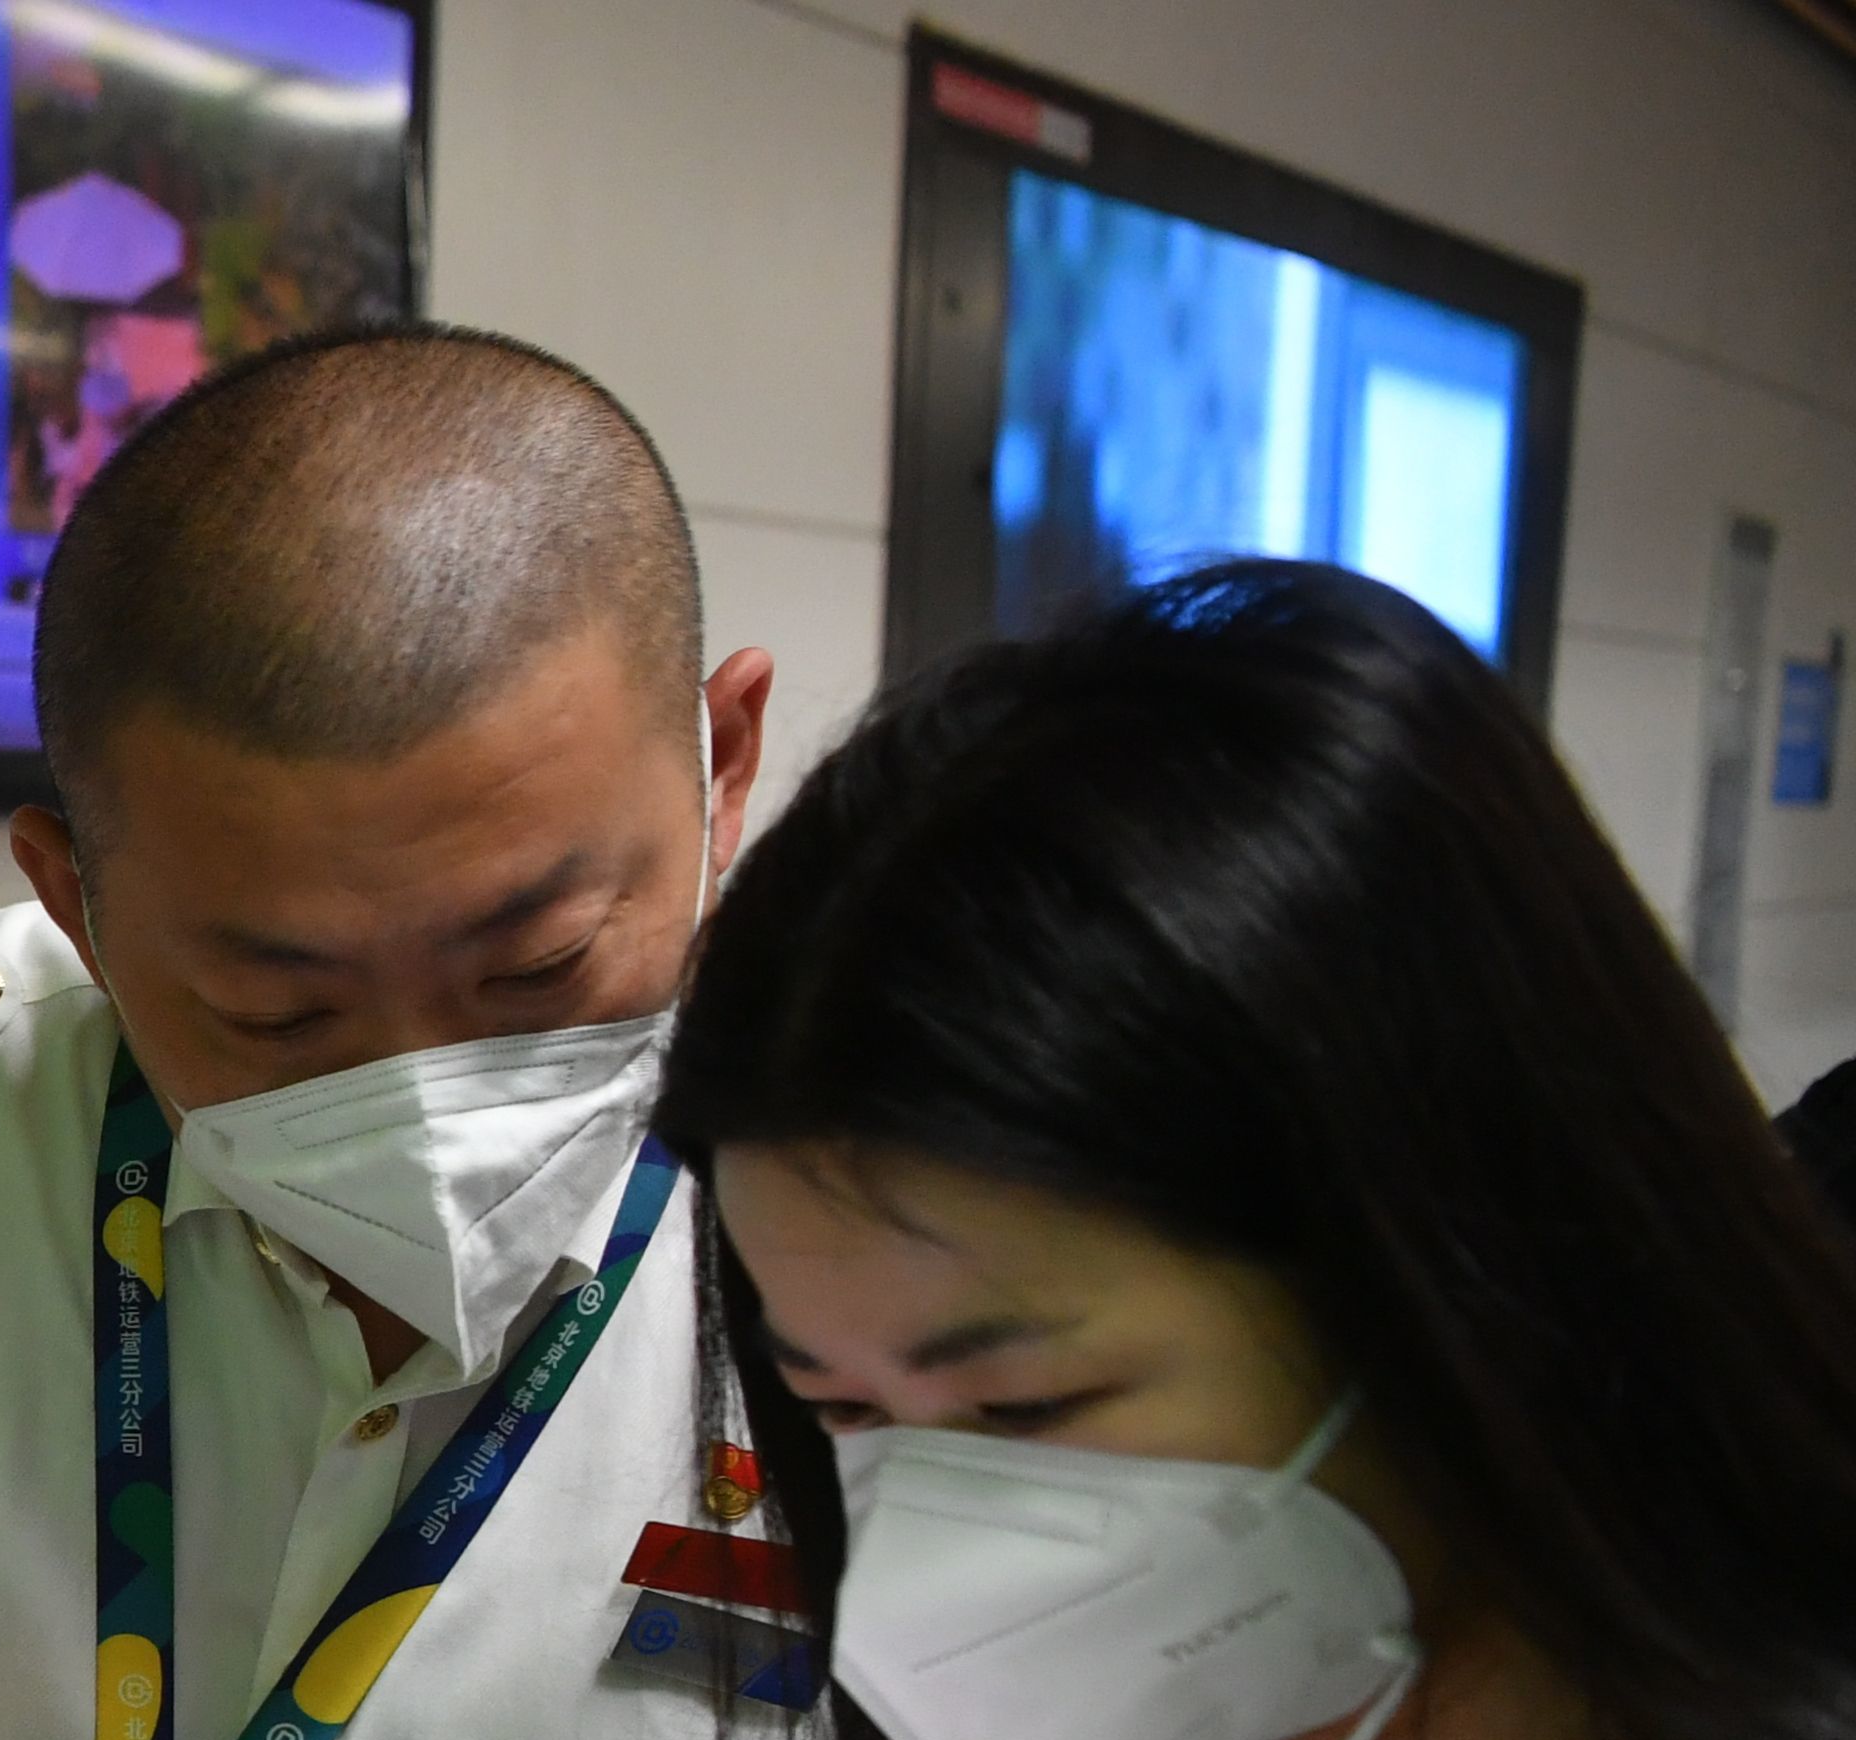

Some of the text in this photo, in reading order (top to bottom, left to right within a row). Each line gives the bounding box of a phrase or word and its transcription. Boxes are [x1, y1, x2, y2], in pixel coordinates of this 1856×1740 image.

[116, 1204, 145, 1459] 北京地铁运营三分公司
[417, 1318, 580, 1546] 北京地铁运营三分公司
